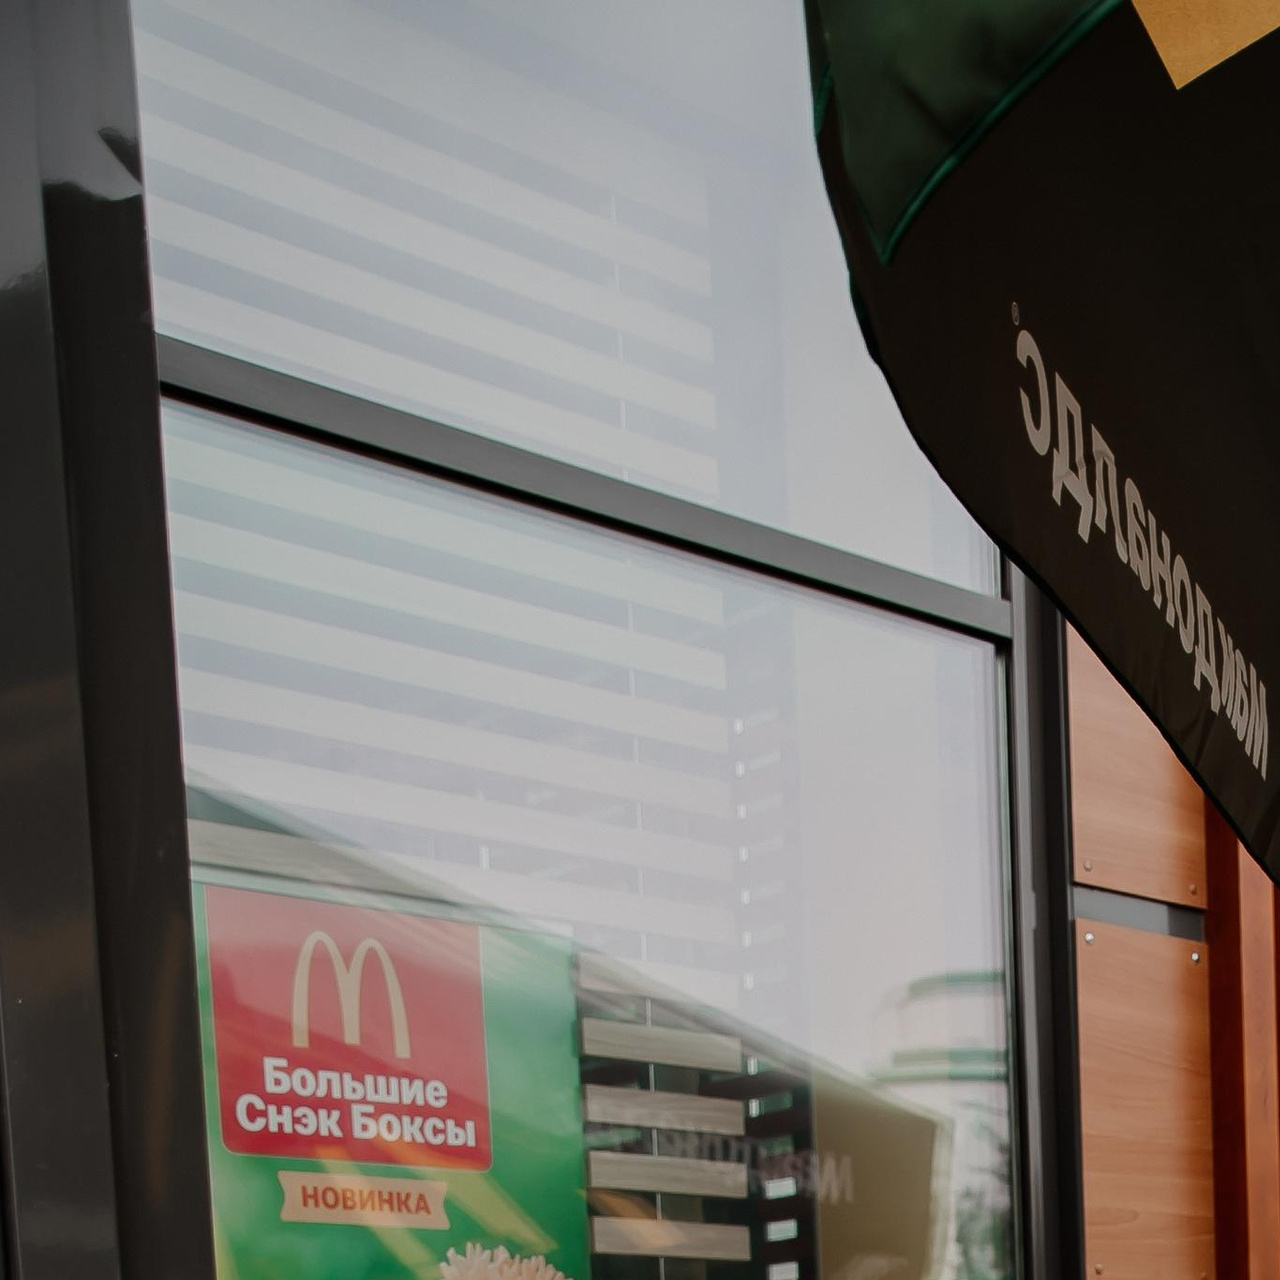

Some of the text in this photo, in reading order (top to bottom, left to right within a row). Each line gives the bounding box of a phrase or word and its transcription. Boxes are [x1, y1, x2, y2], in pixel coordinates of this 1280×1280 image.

[263, 1056, 449, 1109] Большие
[235, 1094, 476, 1149] Снэк Боксы
[301, 1185, 431, 1216] НОВИНКА
